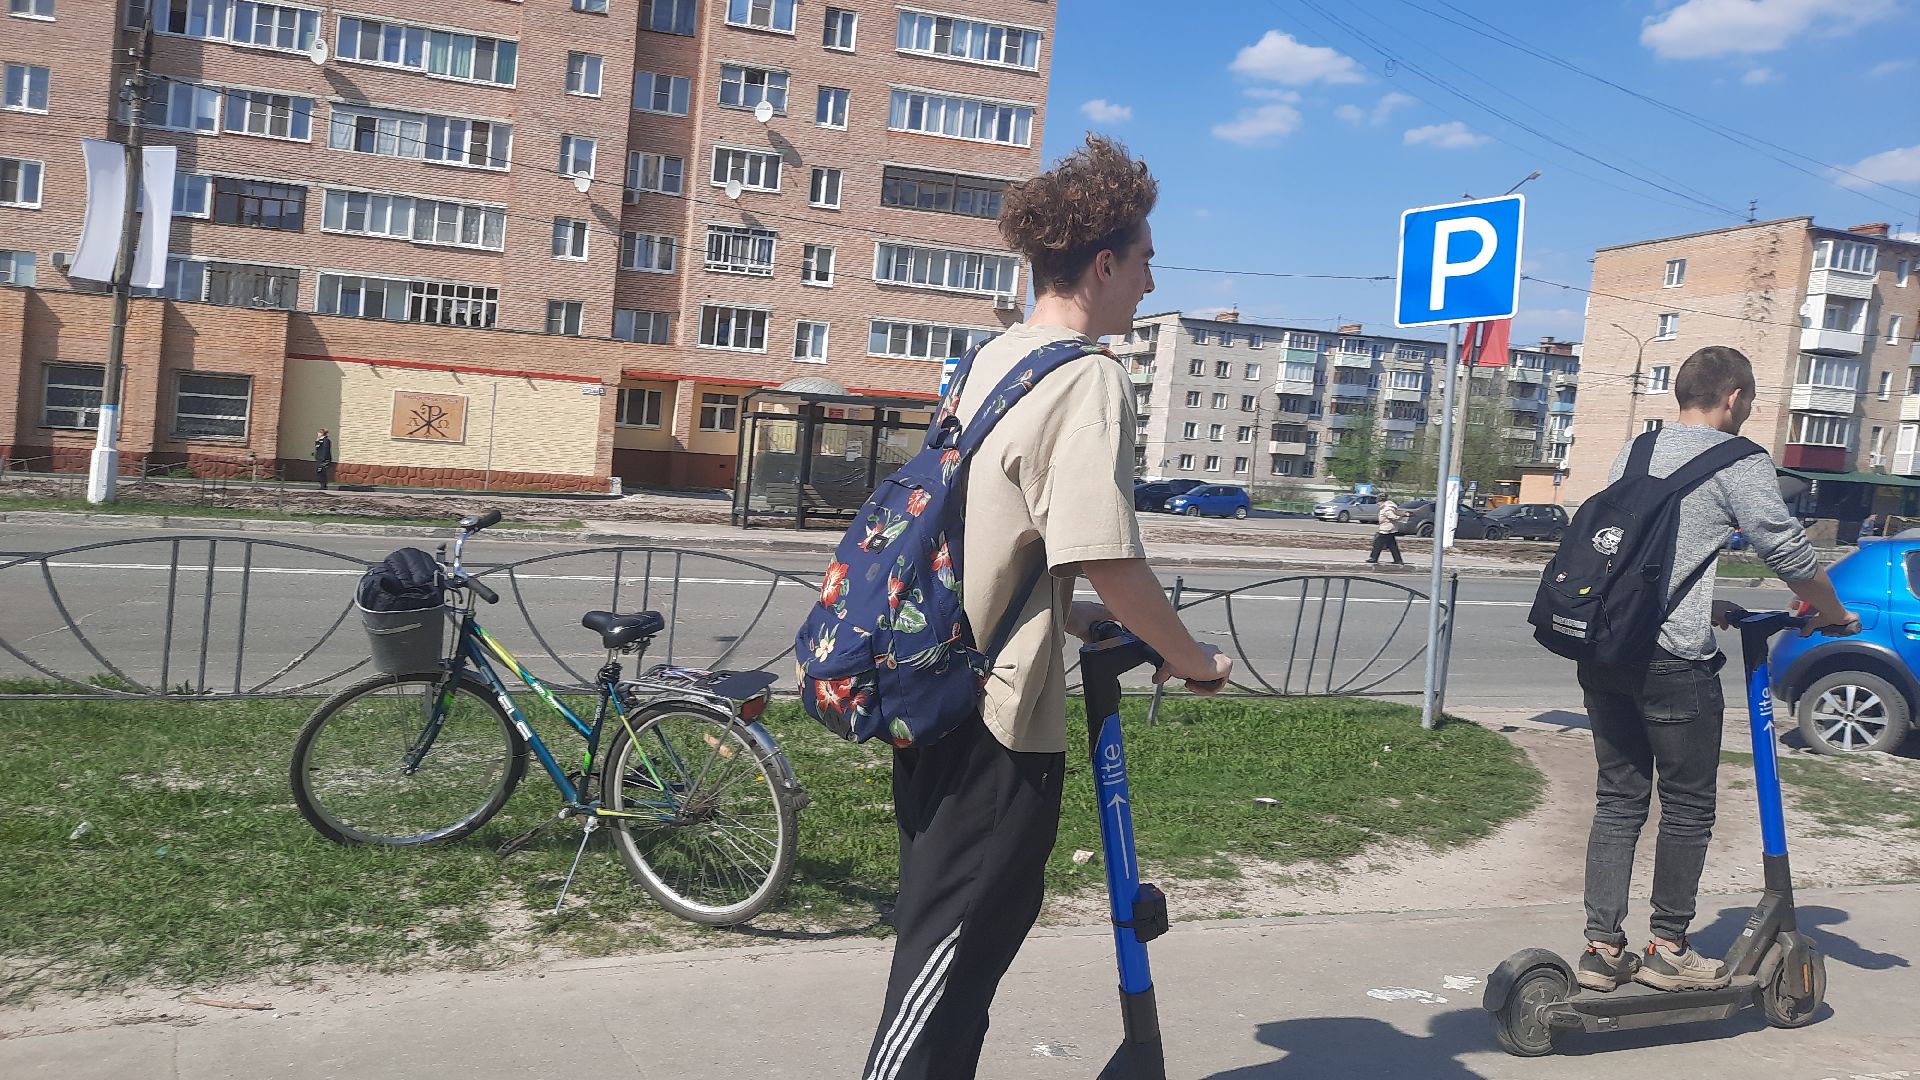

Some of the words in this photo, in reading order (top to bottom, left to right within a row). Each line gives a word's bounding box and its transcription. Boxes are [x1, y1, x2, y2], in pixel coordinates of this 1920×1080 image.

[1429, 216, 1498, 311] P
[1758, 687, 1773, 716] lite
[1101, 743, 1124, 786] lite
